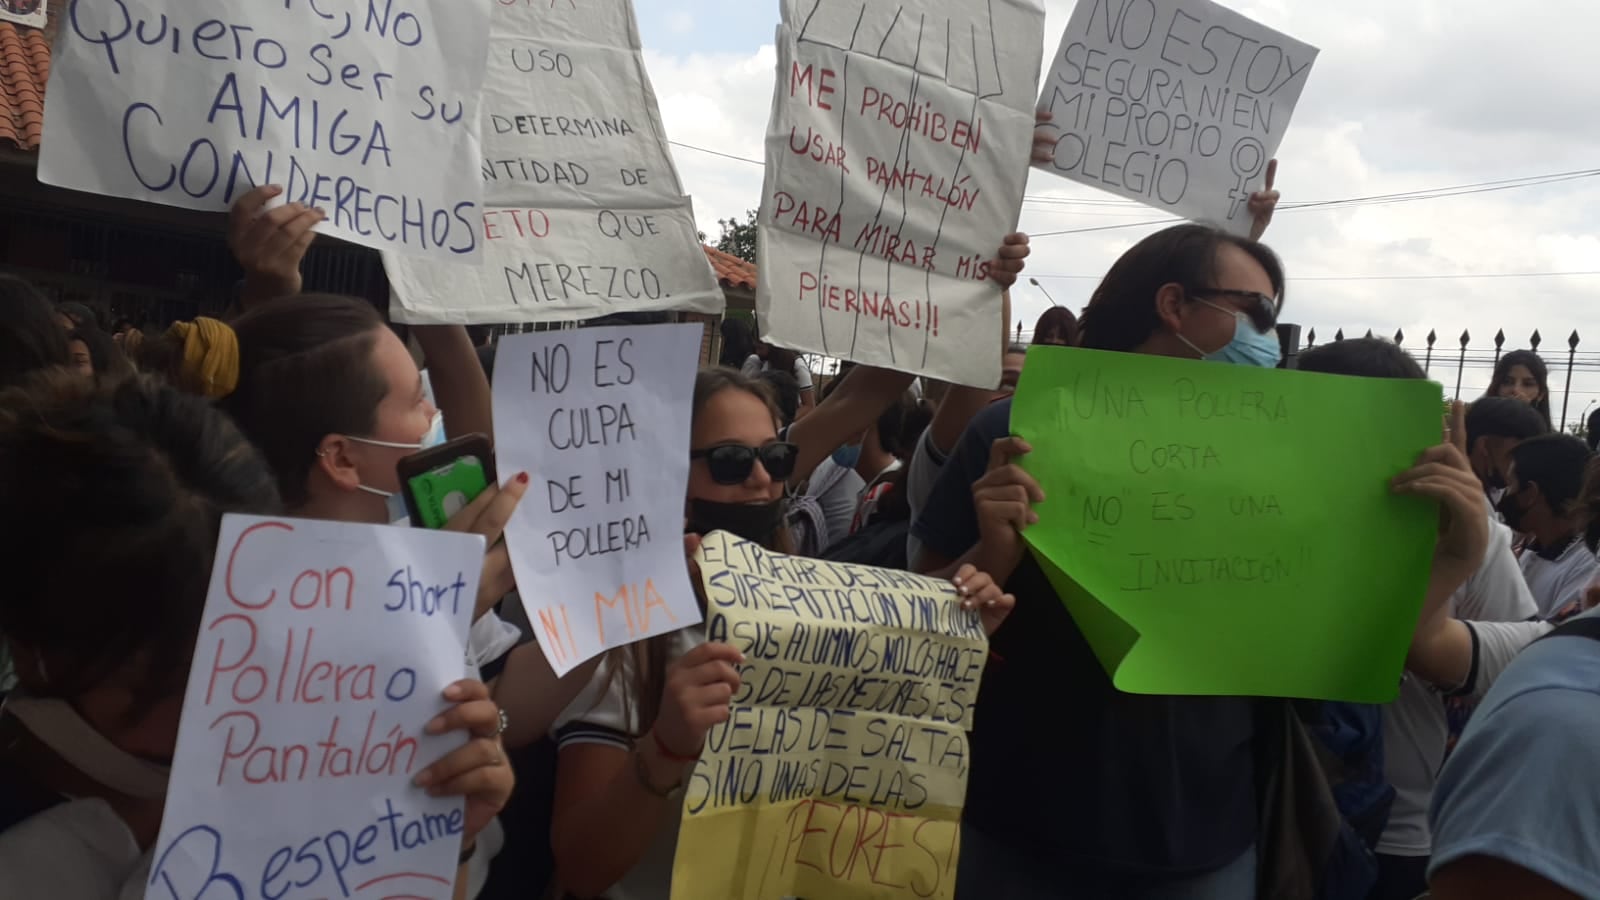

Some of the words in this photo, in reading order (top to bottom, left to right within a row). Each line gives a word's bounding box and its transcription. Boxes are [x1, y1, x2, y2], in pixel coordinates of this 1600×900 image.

[511, 49, 574, 78] USO
[1086, 0, 1156, 49] NO
[1160, 8, 1310, 97] ESTOY
[790, 61, 836, 110] ME
[1058, 42, 1188, 112] SEGURA
[1232, 92, 1275, 134] EN
[207, 72, 391, 167] AMIGA
[122, 102, 273, 204] CON
[286, 155, 477, 254] DERECHOS
[481, 157, 590, 186] NTIDAD
[620, 168, 649, 187] DE
[789, 126, 850, 174] USAR
[866, 157, 980, 212] PANTALÓN
[482, 209, 550, 240] ETO
[598, 210, 660, 241] QUE
[774, 192, 842, 244] PARA
[504, 262, 671, 305] MEREZCO.
[531, 343, 570, 394] NO
[594, 337, 635, 388] ES
[548, 402, 636, 450] CULPA
[1173, 376, 1290, 424] POLLERA
[1129, 438, 1222, 474] CORTA
[547, 475, 586, 514] DE
[605, 468, 630, 504] MI
[1151, 491, 1196, 521] ES
[1228, 494, 1284, 517] UNA
[225, 521, 355, 611] Con
[547, 514, 651, 566] POLLERA
[702, 532, 737, 569] EL
[538, 604, 578, 666] NI
[594, 577, 678, 645] MIA
[918, 594, 939, 633] NO
[205, 613, 376, 705] Pollera
[709, 612, 727, 644] A
[733, 620, 780, 660] SUS
[783, 623, 880, 674] ALUMNOS
[933, 643, 983, 683] HACE
[754, 667, 801, 706] DE
[798, 671, 841, 708] LAS
[837, 675, 932, 719] MEJORES
[208, 710, 418, 786] Pantalón
[708, 706, 802, 755] UELAS
[807, 708, 856, 750] DE
[687, 756, 763, 814] SINO
[821, 762, 868, 802] DE
[870, 766, 927, 809] LAS
